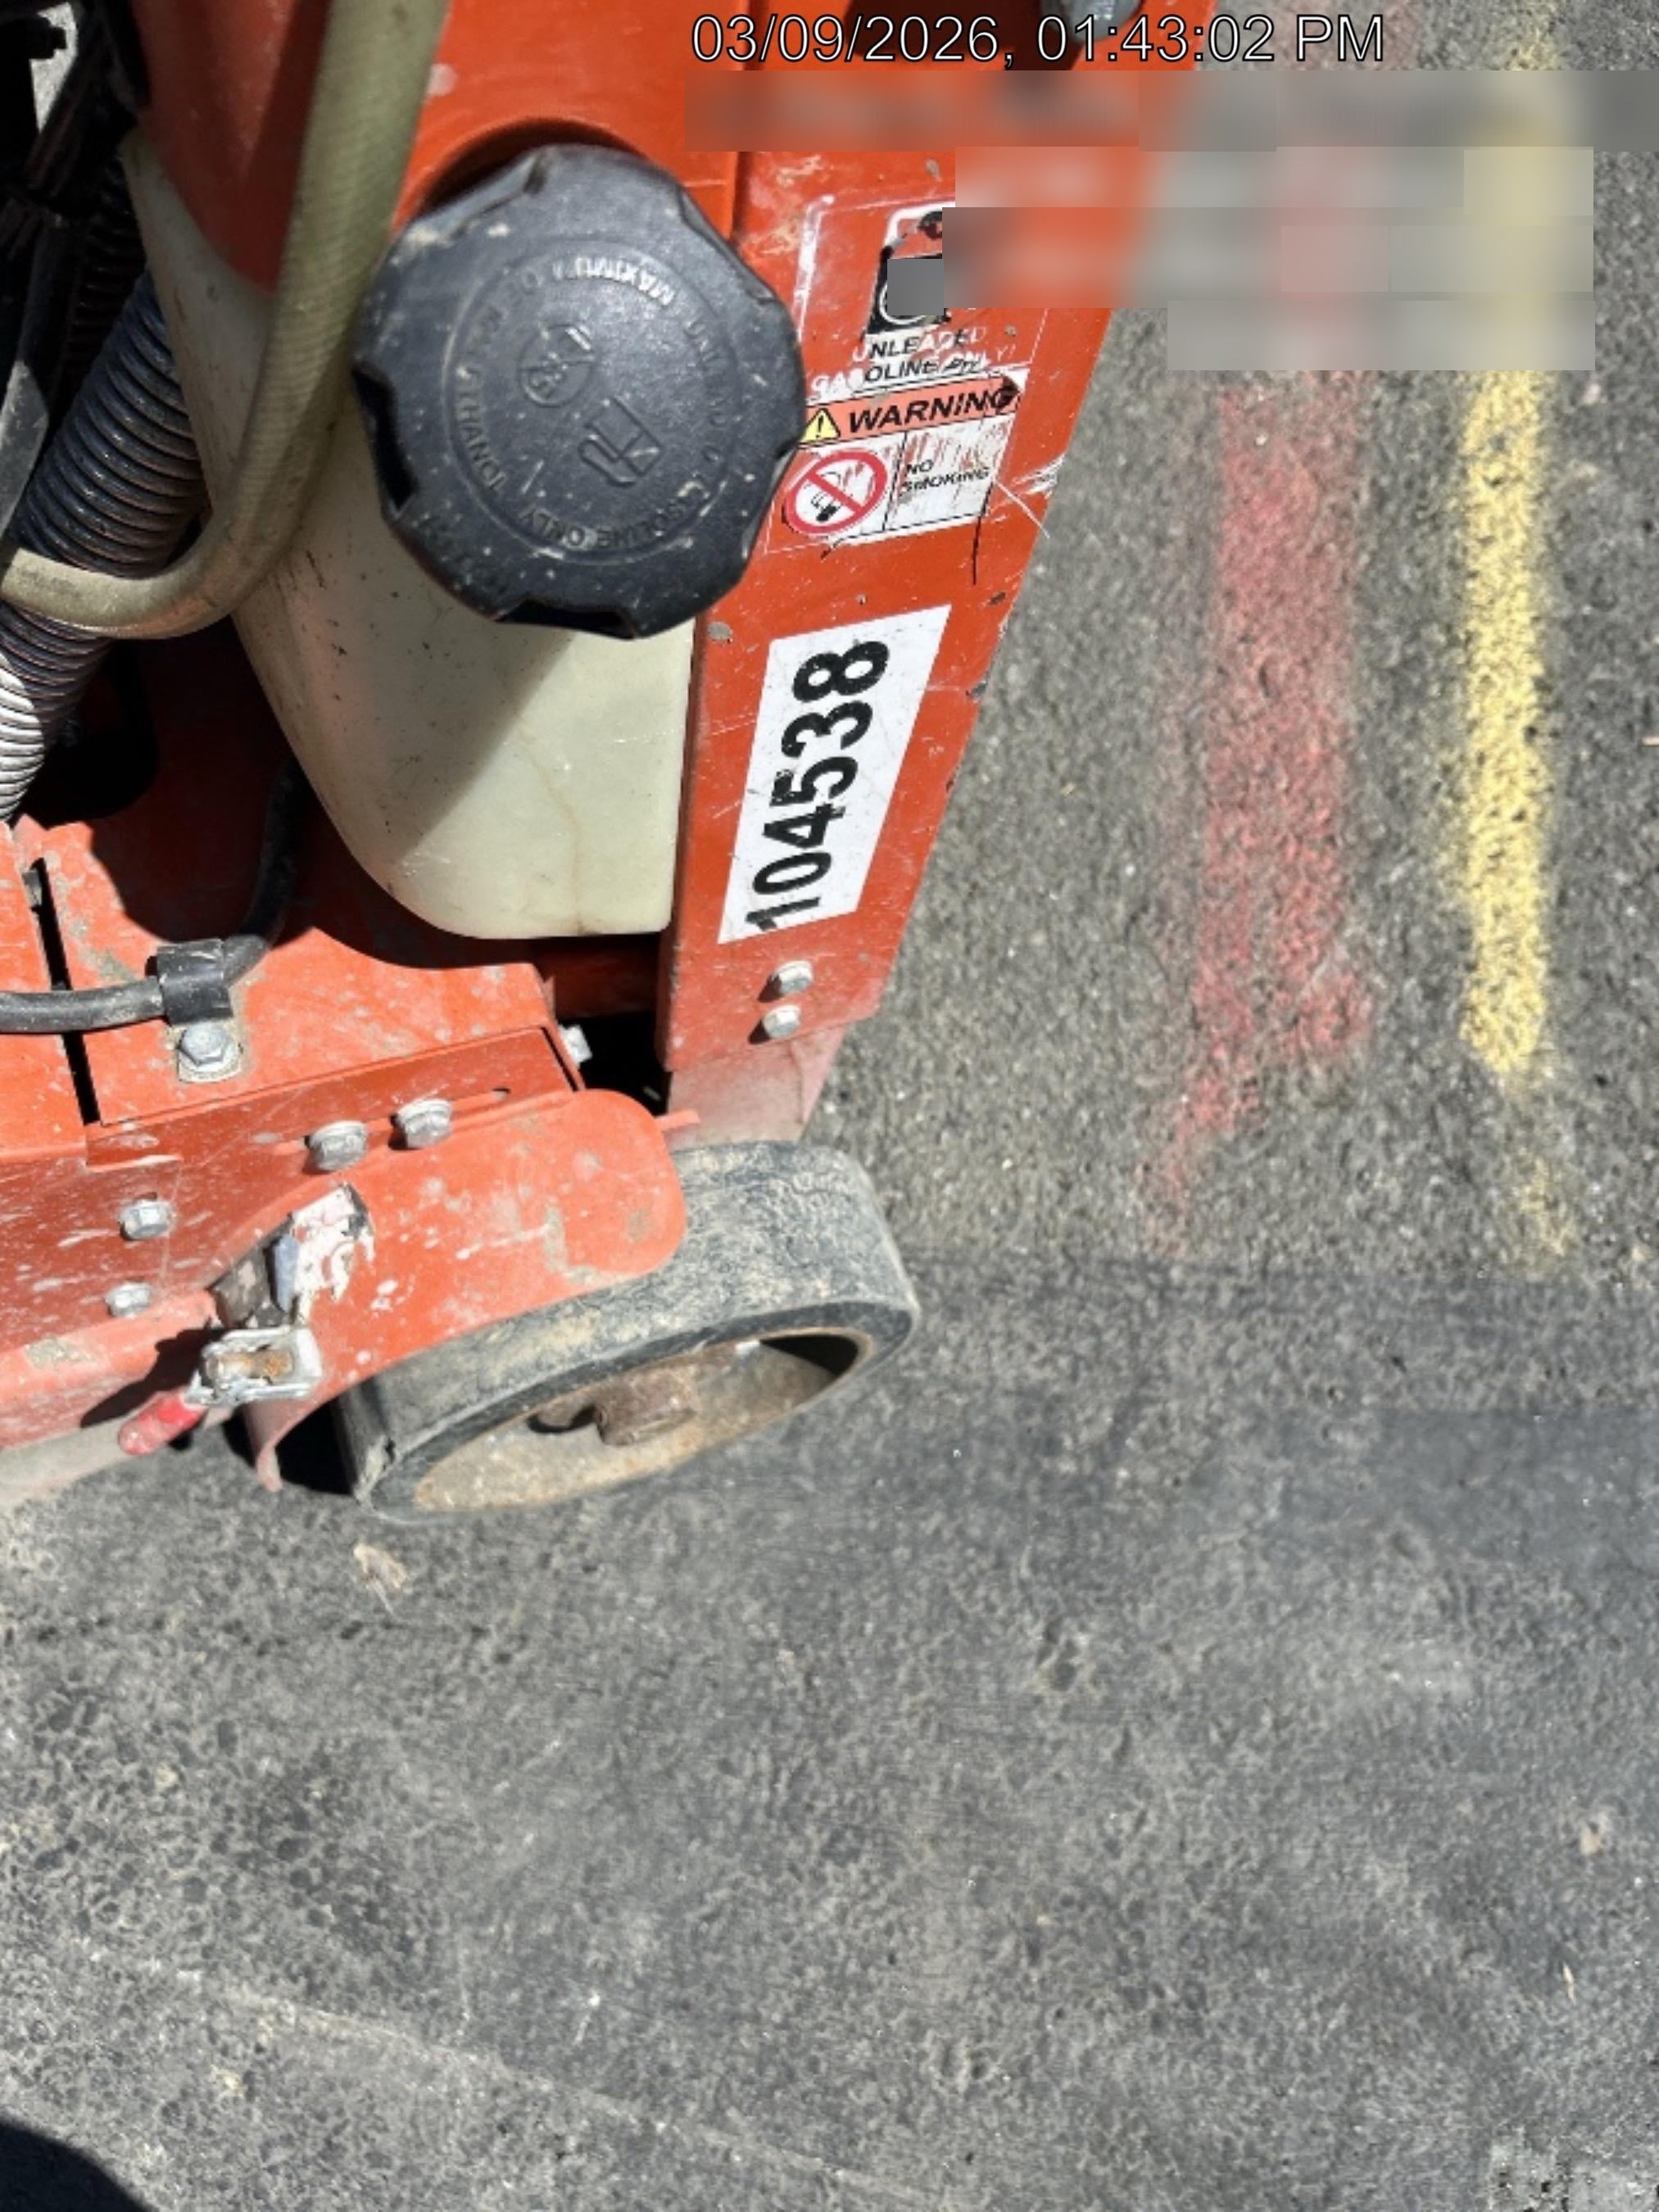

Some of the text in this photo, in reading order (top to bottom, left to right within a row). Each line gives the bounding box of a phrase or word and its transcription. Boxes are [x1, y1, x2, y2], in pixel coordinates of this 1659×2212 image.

[849, 387, 1014, 434] WARNING
[902, 468, 990, 492] SMOKING
[905, 459, 935, 475] NO
[746, 641, 891, 932] 104538
